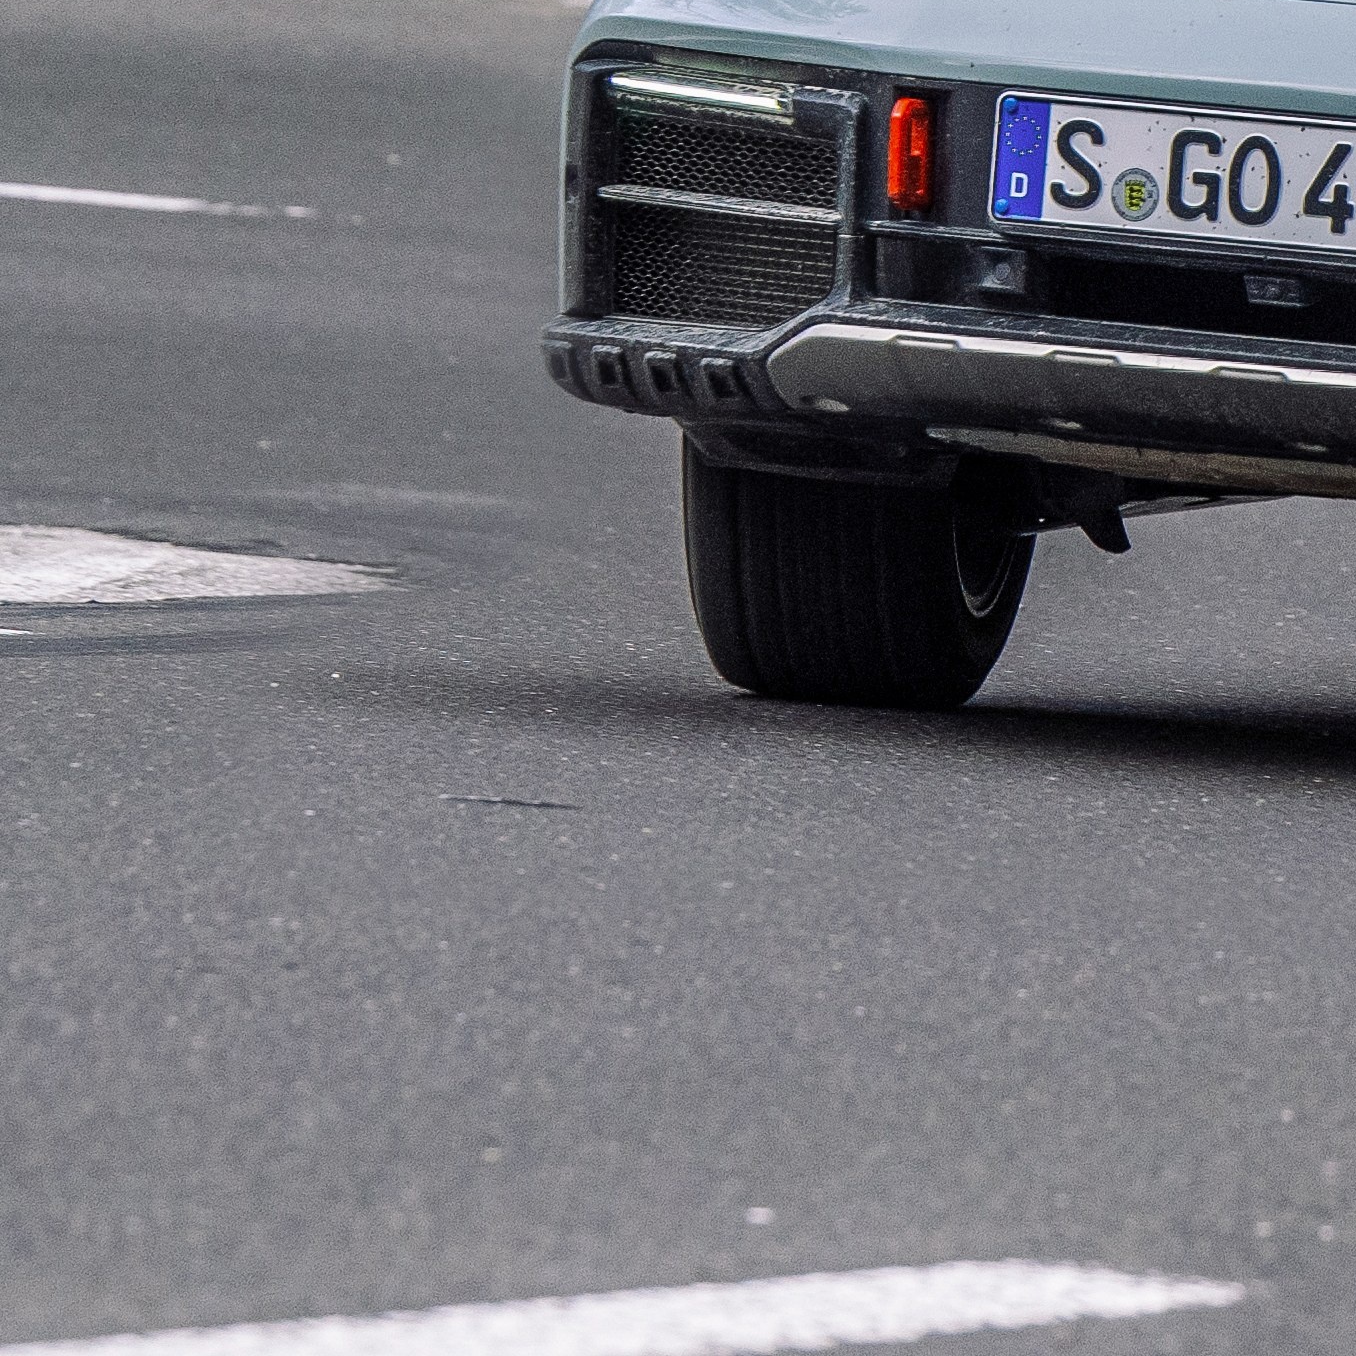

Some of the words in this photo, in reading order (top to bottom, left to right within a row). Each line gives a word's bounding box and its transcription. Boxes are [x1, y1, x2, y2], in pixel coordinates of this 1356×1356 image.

[1009, 172, 1029, 198] D
[1049, 119, 1105, 210] S
[1166, 129, 1282, 226] GO
